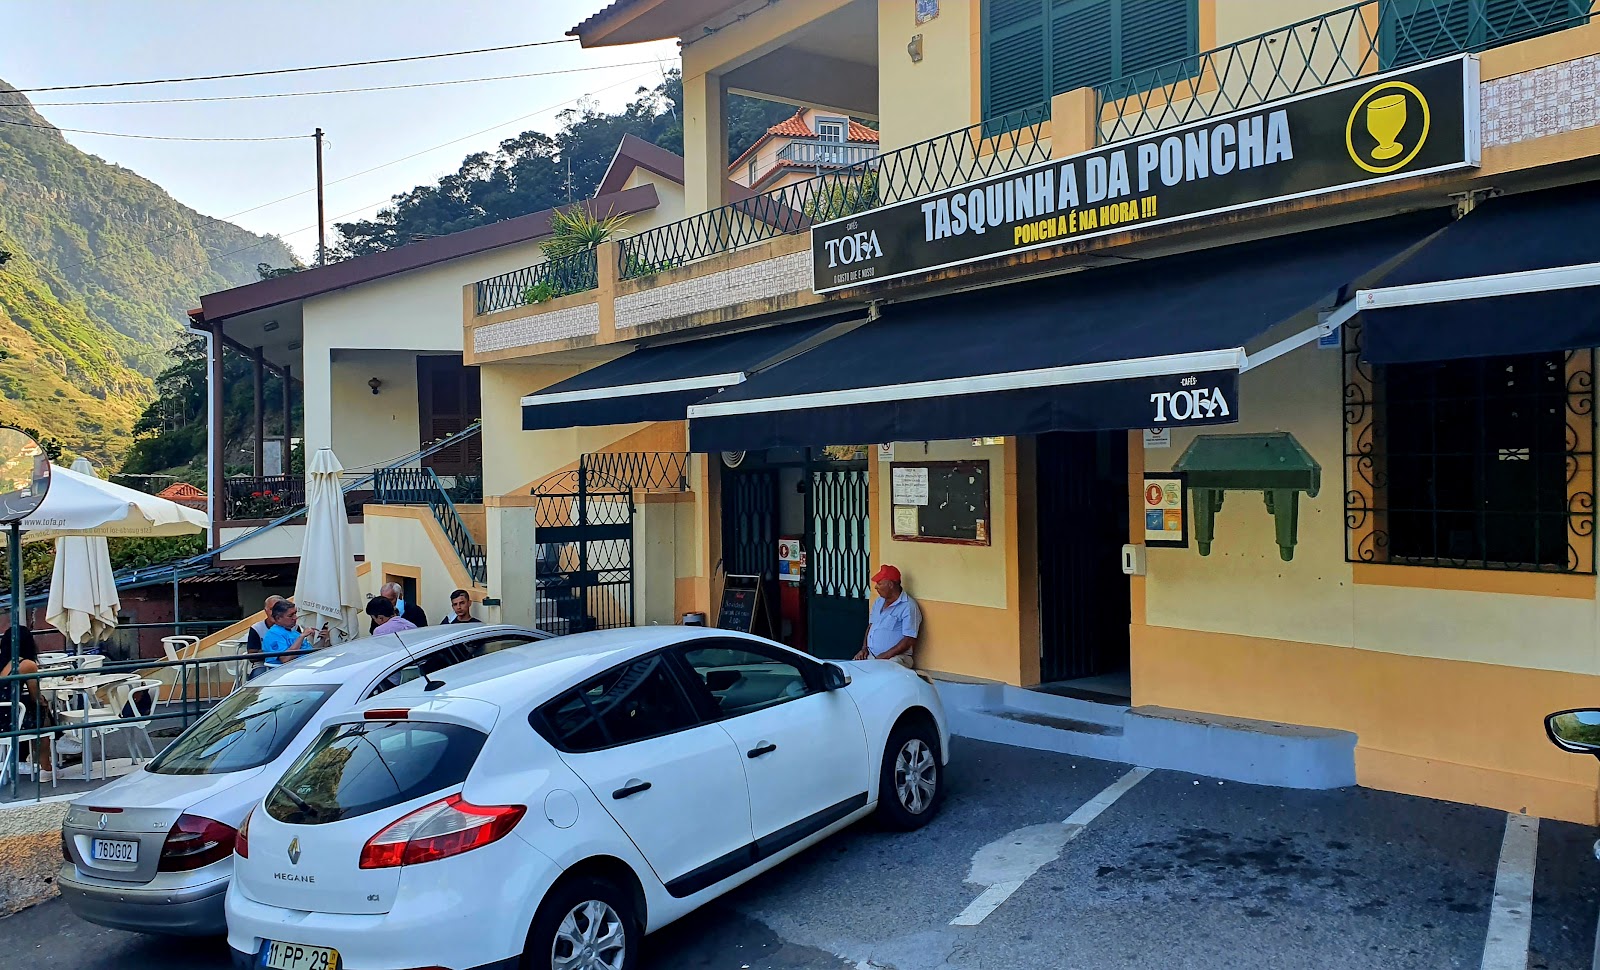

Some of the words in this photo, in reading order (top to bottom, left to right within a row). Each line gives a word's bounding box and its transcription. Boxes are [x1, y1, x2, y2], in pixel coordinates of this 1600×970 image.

[921, 163, 1080, 242] TASQUINHA
[1086, 150, 1131, 204] DA
[1138, 109, 1294, 193] PONCHA
[1014, 215, 1067, 245] PONCHA
[1069, 210, 1077, 233] É
[1079, 208, 1098, 231] NA
[1100, 201, 1139, 226] HORA
[1141, 195, 1157, 217] !!!
[824, 229, 883, 268] TOFA
[1181, 376, 1197, 386] CAFÉS
[1150, 386, 1230, 422] TOFA
[24, 517, 66, 526] www.tofa.pt
[98, 842, 132, 860] 76DG02
[274, 873, 315, 883] MEGANE
